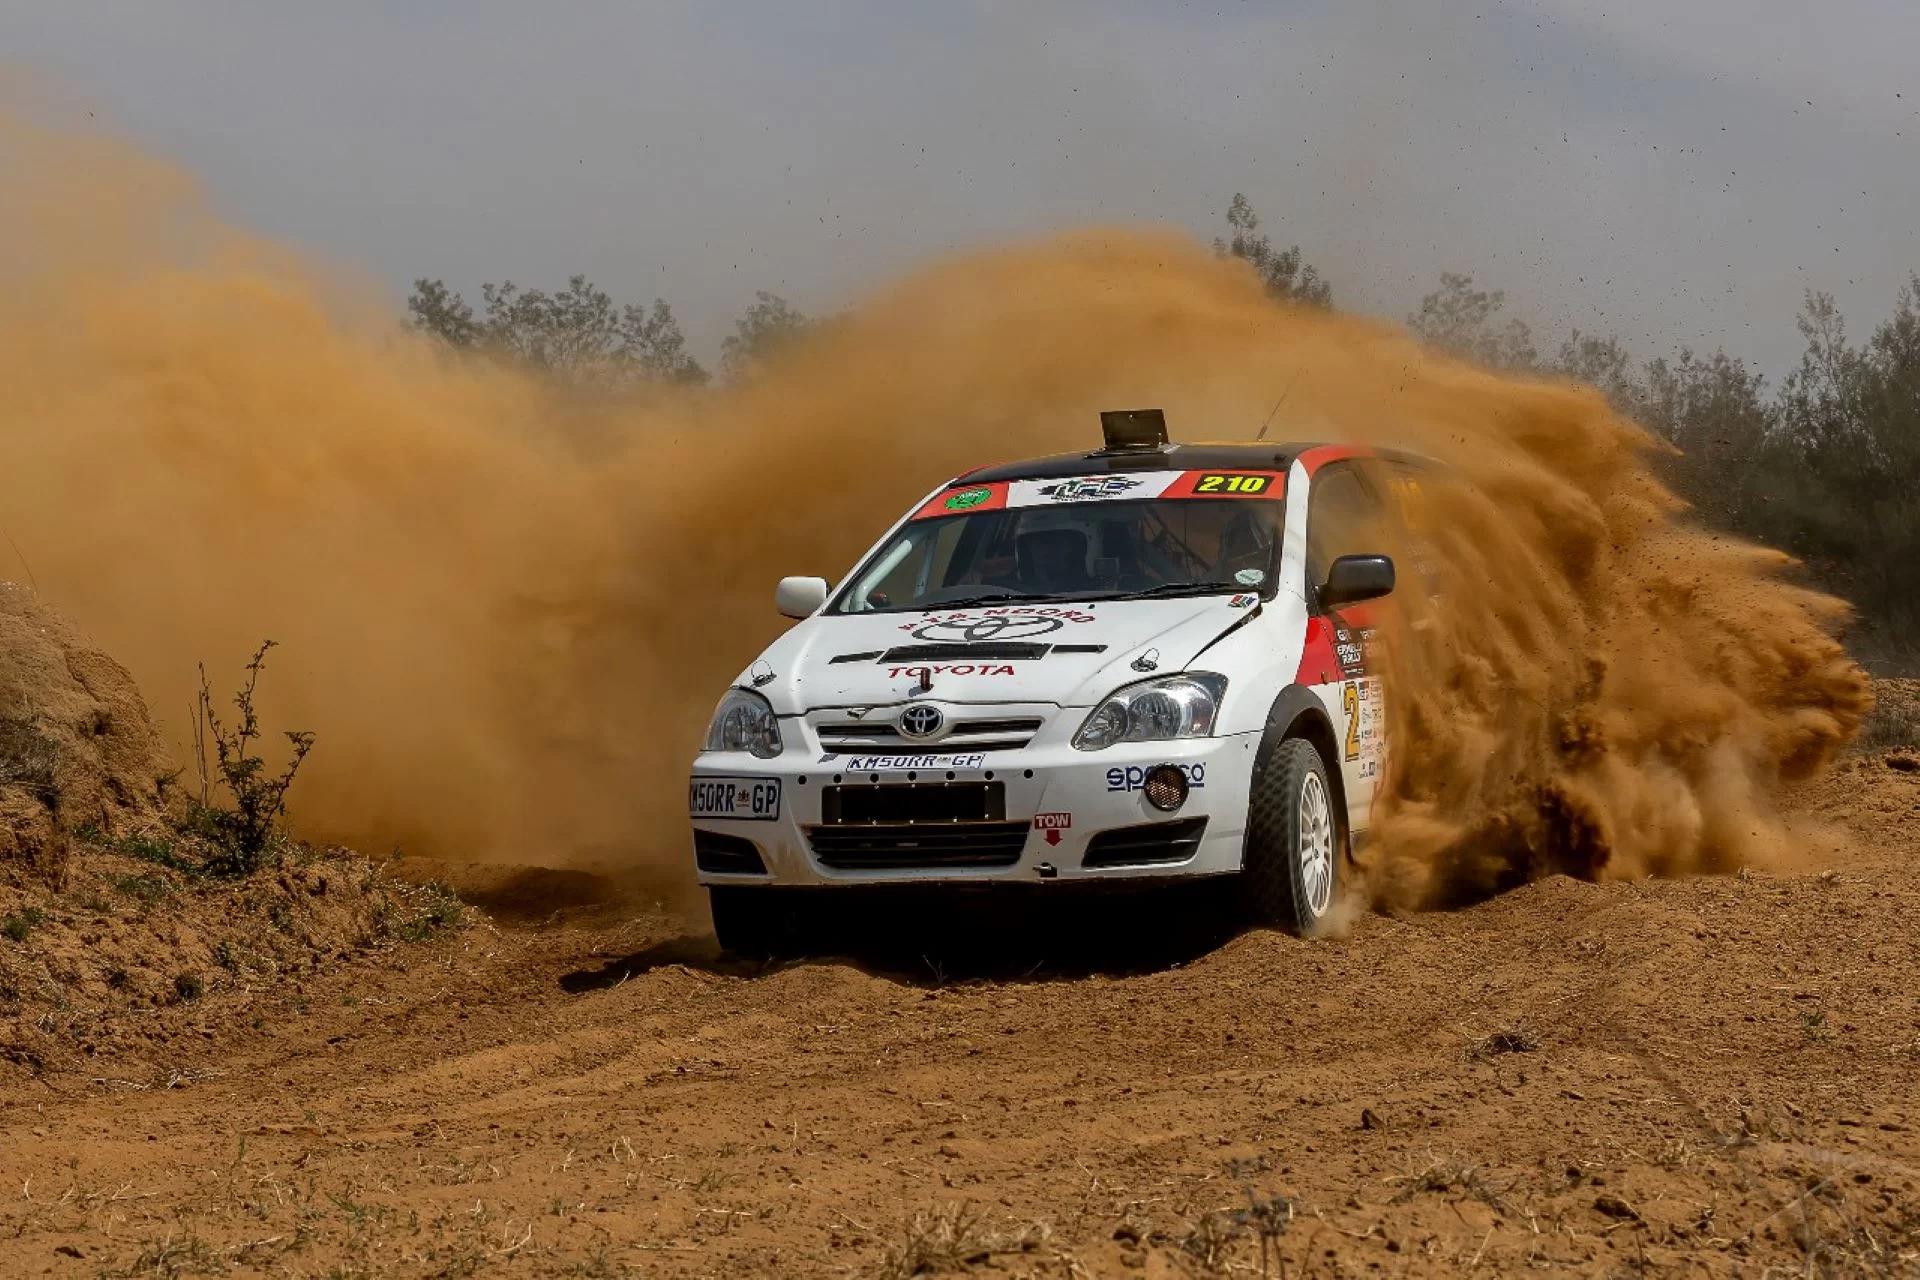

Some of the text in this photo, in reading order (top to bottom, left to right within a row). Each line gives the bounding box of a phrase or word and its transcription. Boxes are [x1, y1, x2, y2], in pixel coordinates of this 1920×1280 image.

[1198, 476, 1264, 492] 210
[888, 665, 1015, 679] TOYOTA
[1344, 681, 1360, 762] 2
[951, 755, 982, 766] GP
[752, 783, 777, 813] GP
[1035, 815, 1070, 828] TOW
